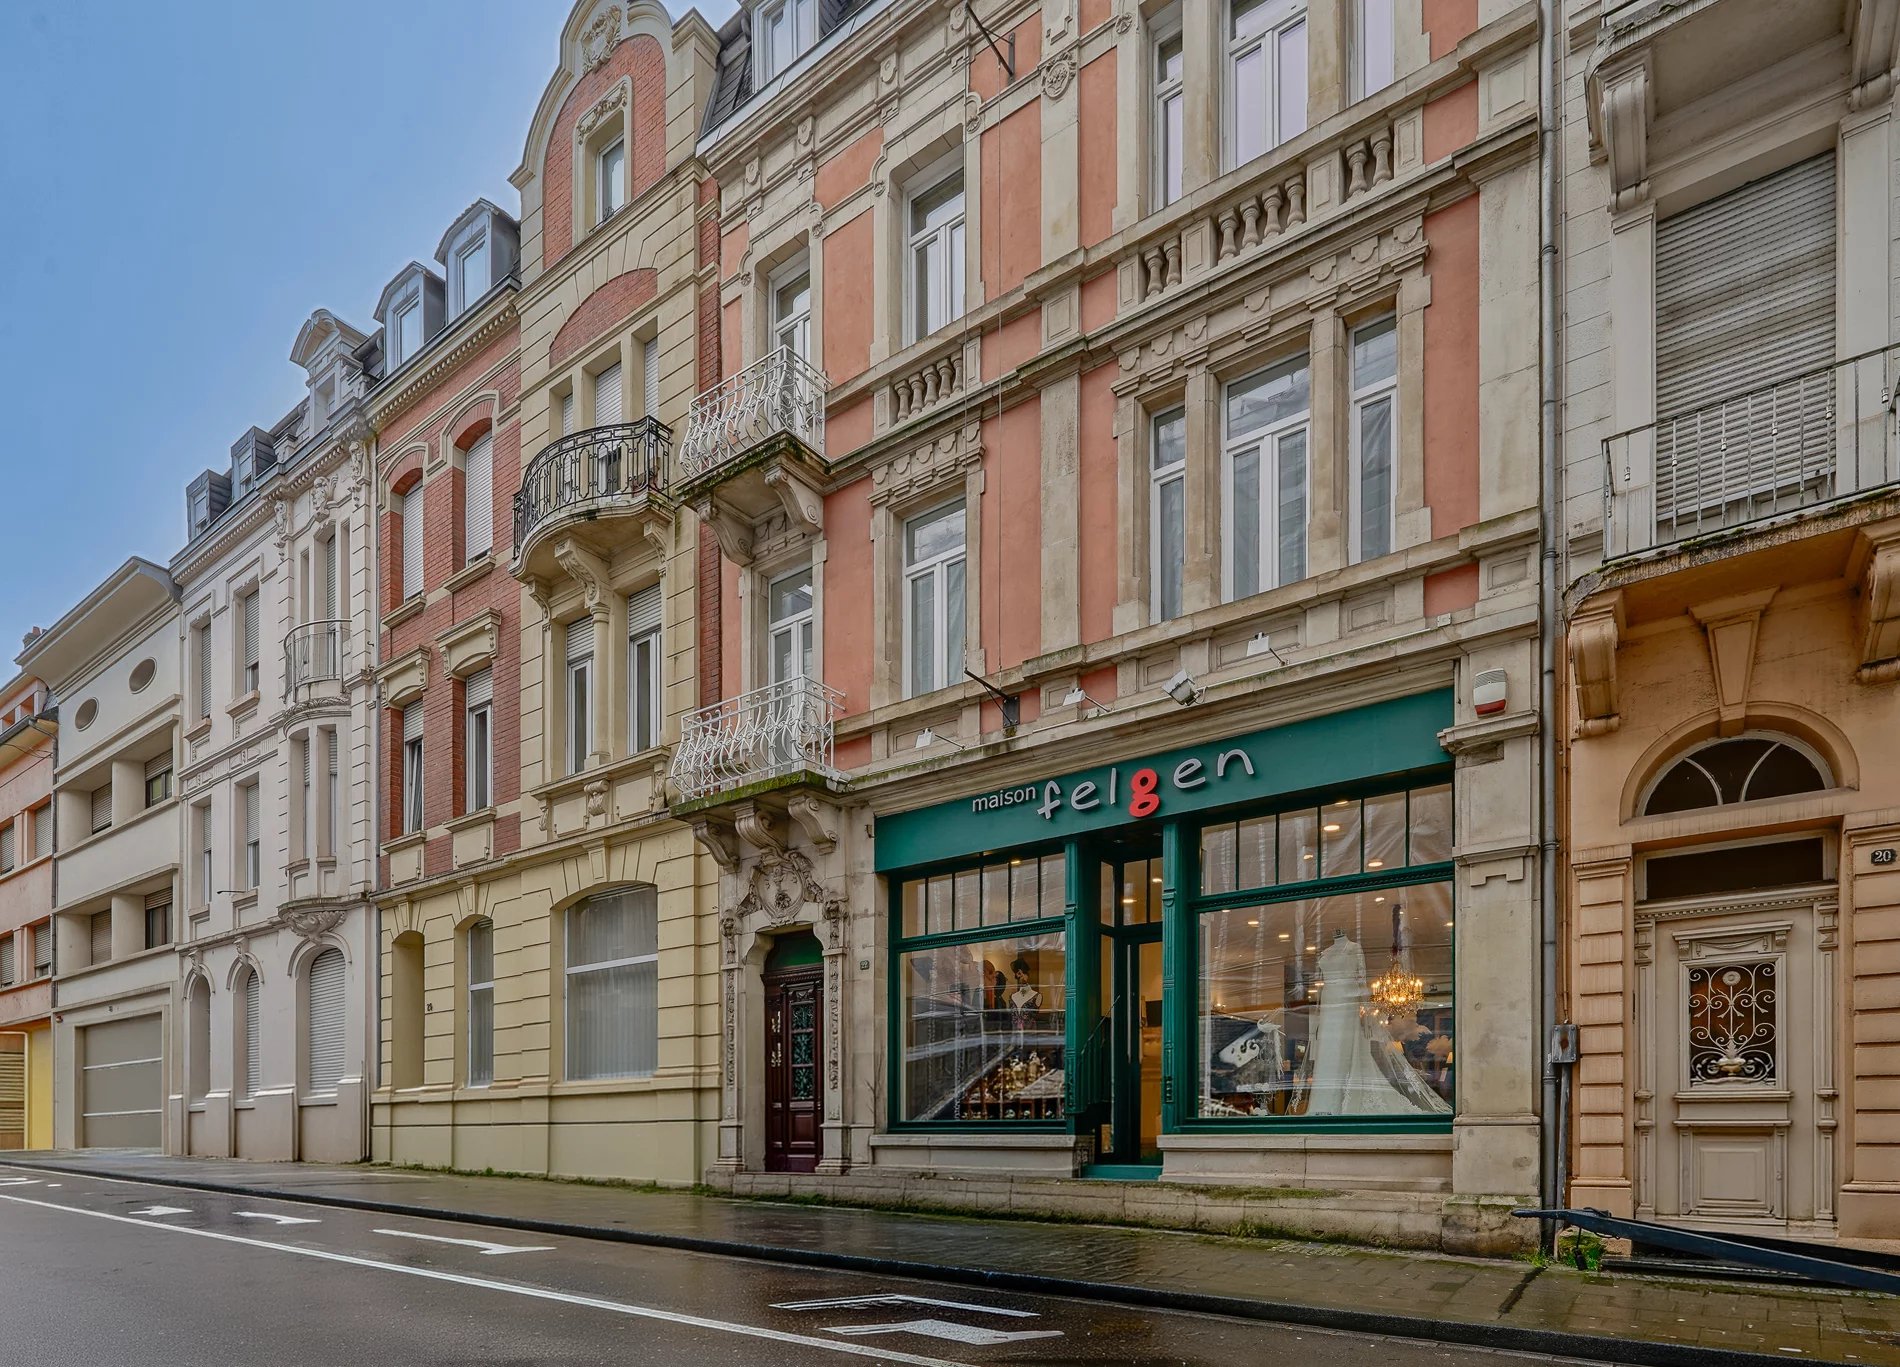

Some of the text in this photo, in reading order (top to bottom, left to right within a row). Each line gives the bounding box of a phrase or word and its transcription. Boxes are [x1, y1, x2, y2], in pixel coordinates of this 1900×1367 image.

[972, 748, 1255, 820] maison felgen
[1874, 850, 1892, 862] 20
